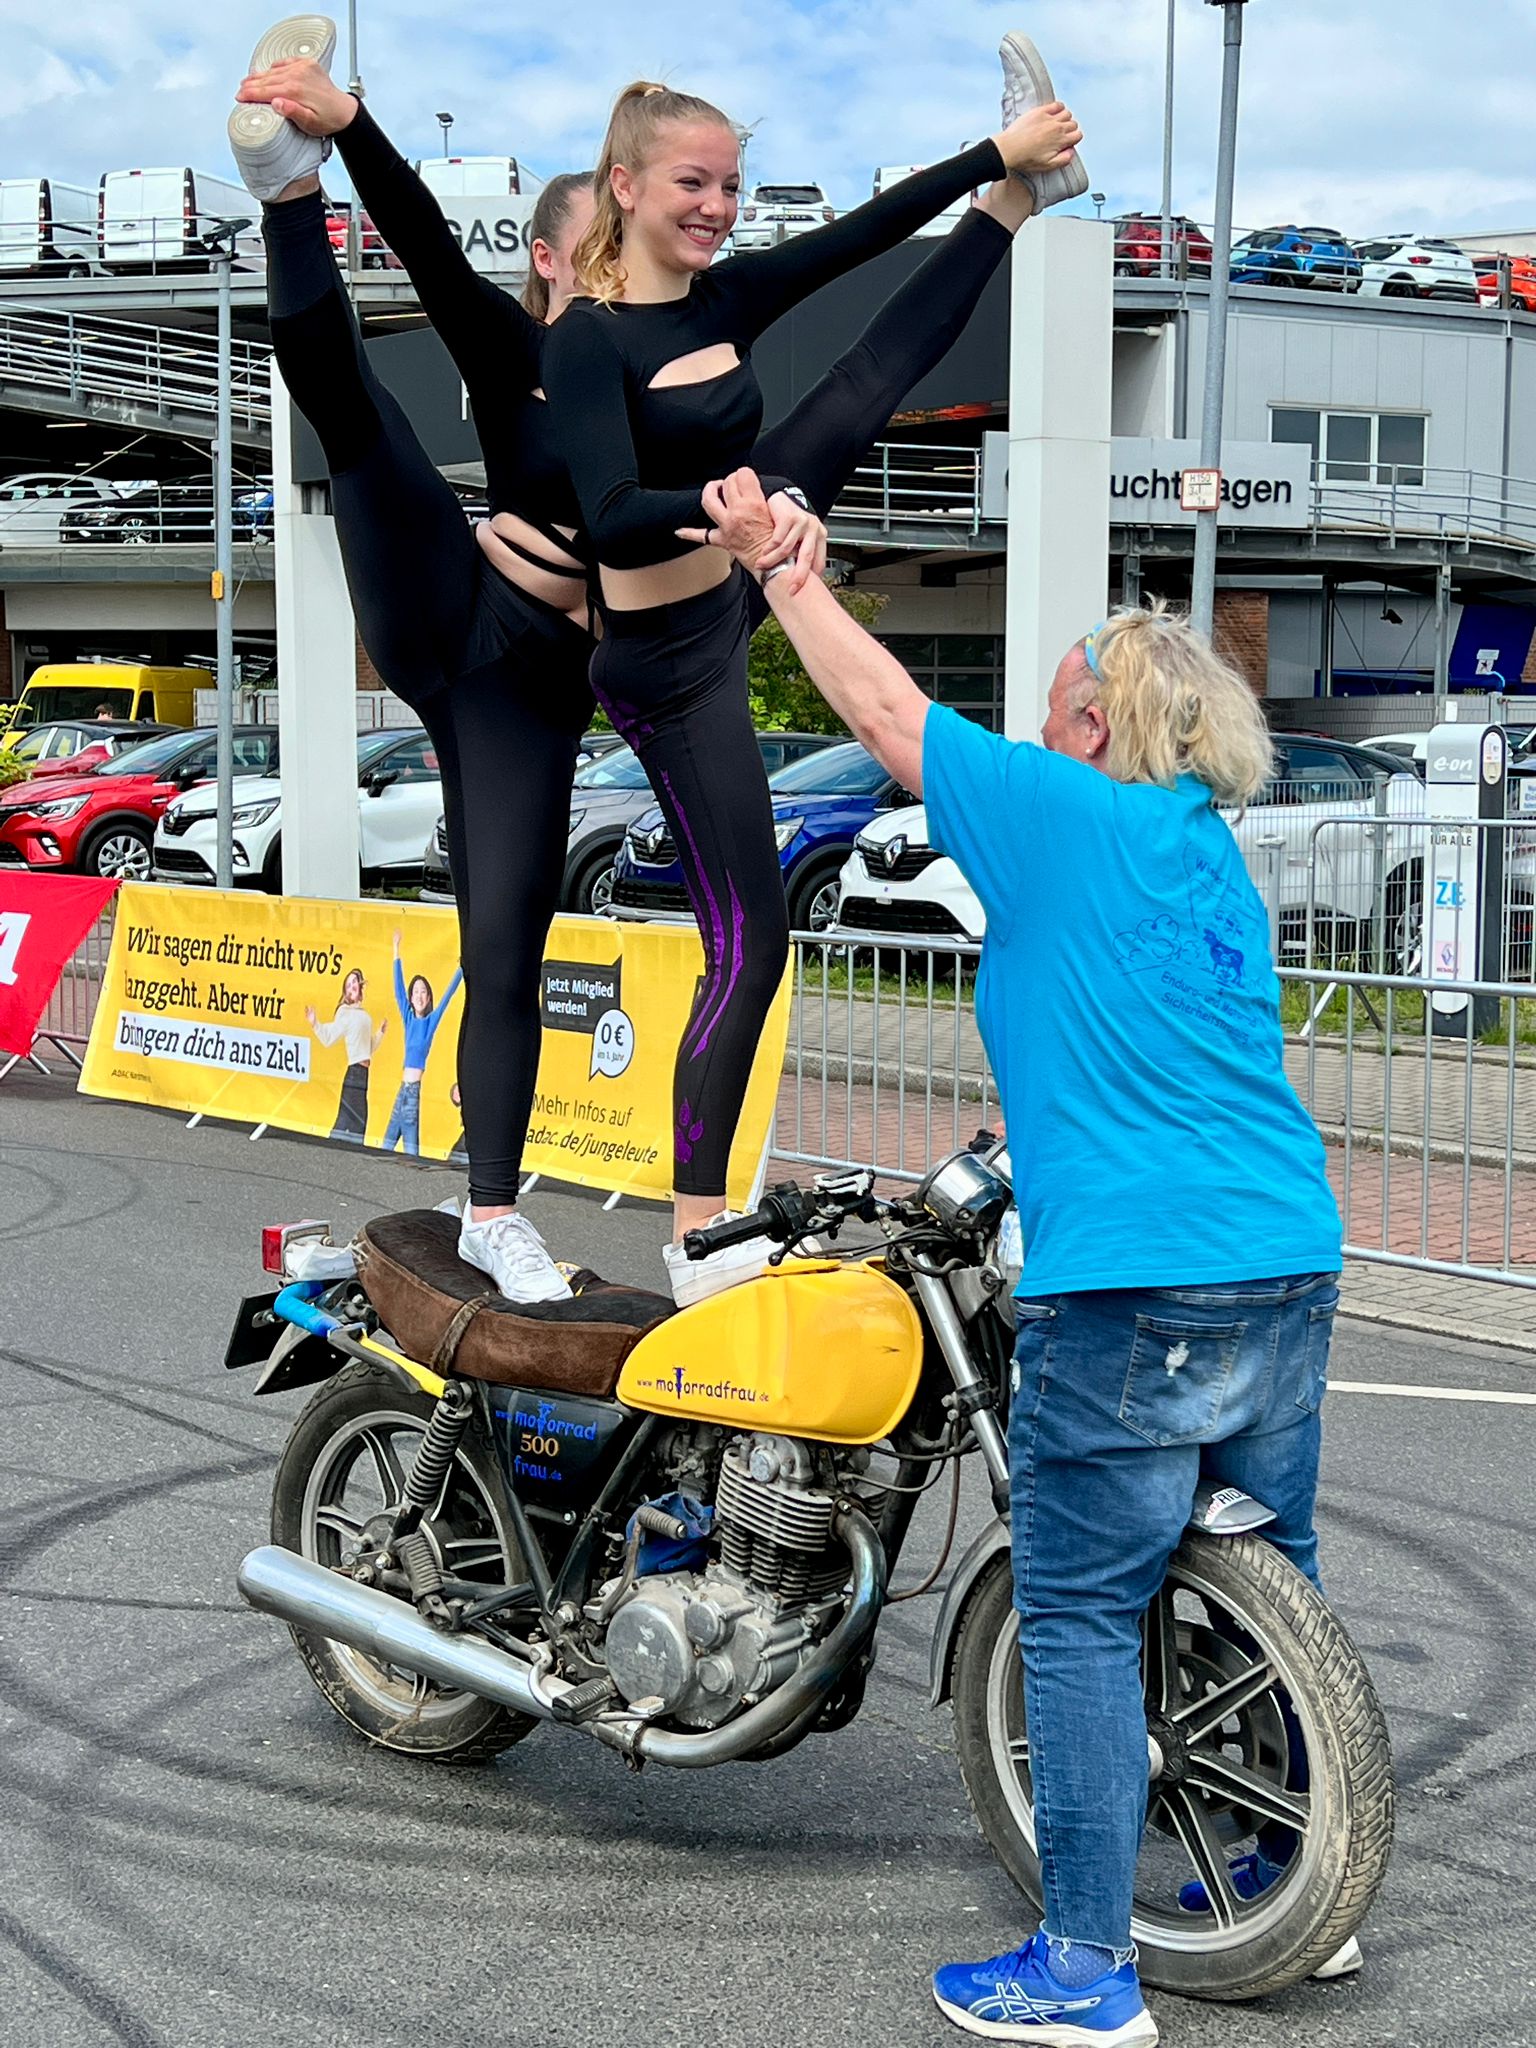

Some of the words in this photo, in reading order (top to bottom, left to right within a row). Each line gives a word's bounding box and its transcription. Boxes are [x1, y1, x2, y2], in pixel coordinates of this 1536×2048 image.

[127, 926, 161, 955] Wir
[164, 934, 213, 967] sagen
[216, 934, 244, 965] dir
[246, 937, 294, 971] nicht
[124, 970, 202, 1011] langgeht.
[206, 983, 250, 1015] Aber
[252, 988, 286, 1020] wir
[571, 979, 615, 999] Mitglied
[547, 1000, 588, 1017] werden!
[183, 1028, 225, 1061] dich
[229, 1043, 263, 1067] ans
[266, 1039, 306, 1074] Ziel.
[601, 1023, 612, 1044] 0
[614, 1025, 625, 1046] €
[532, 1093, 570, 1117] Mehr
[573, 1099, 606, 1124] Infos
[608, 1107, 634, 1127] auf
[526, 1126, 659, 1165] adac.de/jungeleute
[520, 1433, 560, 1457] 500
